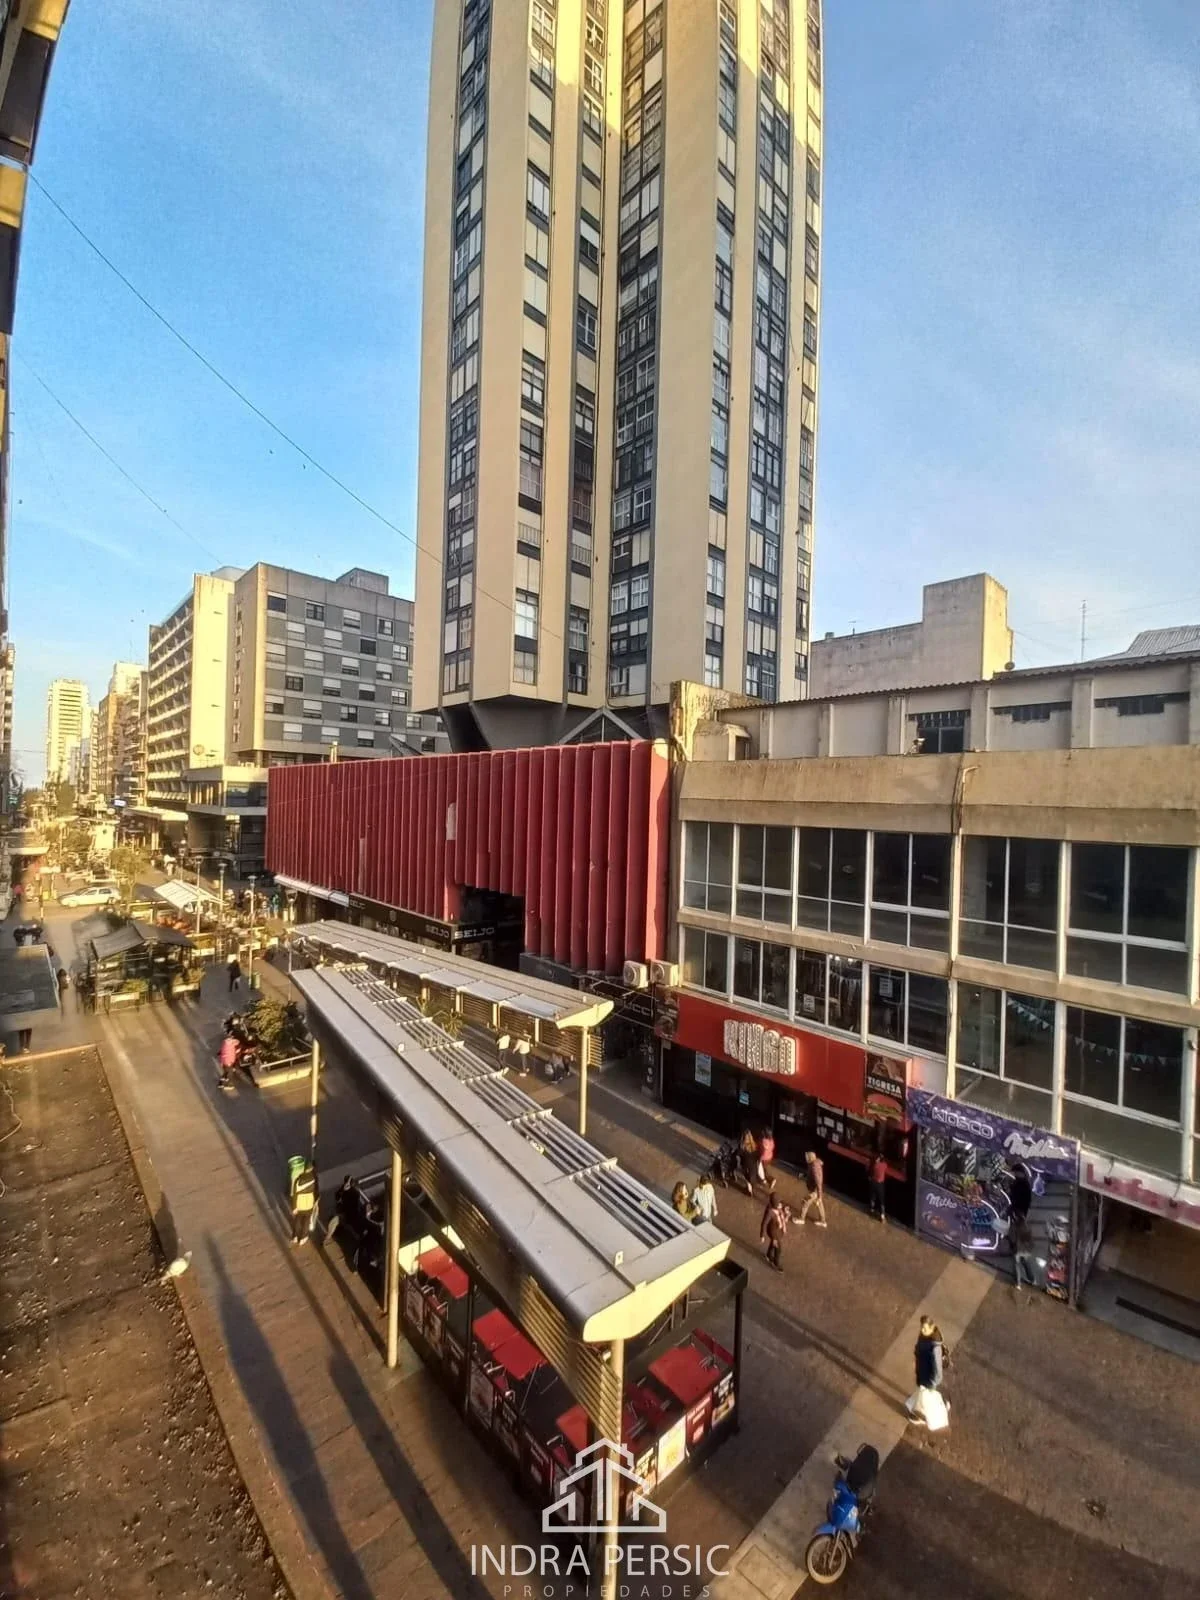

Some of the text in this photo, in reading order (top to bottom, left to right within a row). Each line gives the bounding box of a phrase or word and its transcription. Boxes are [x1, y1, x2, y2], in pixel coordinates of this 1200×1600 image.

[454, 927, 496, 940] SEIJO
[868, 1076, 903, 1095] TIGRESA
[931, 1106, 995, 1140] KIOSCO
[925, 1192, 959, 1210] Milka
